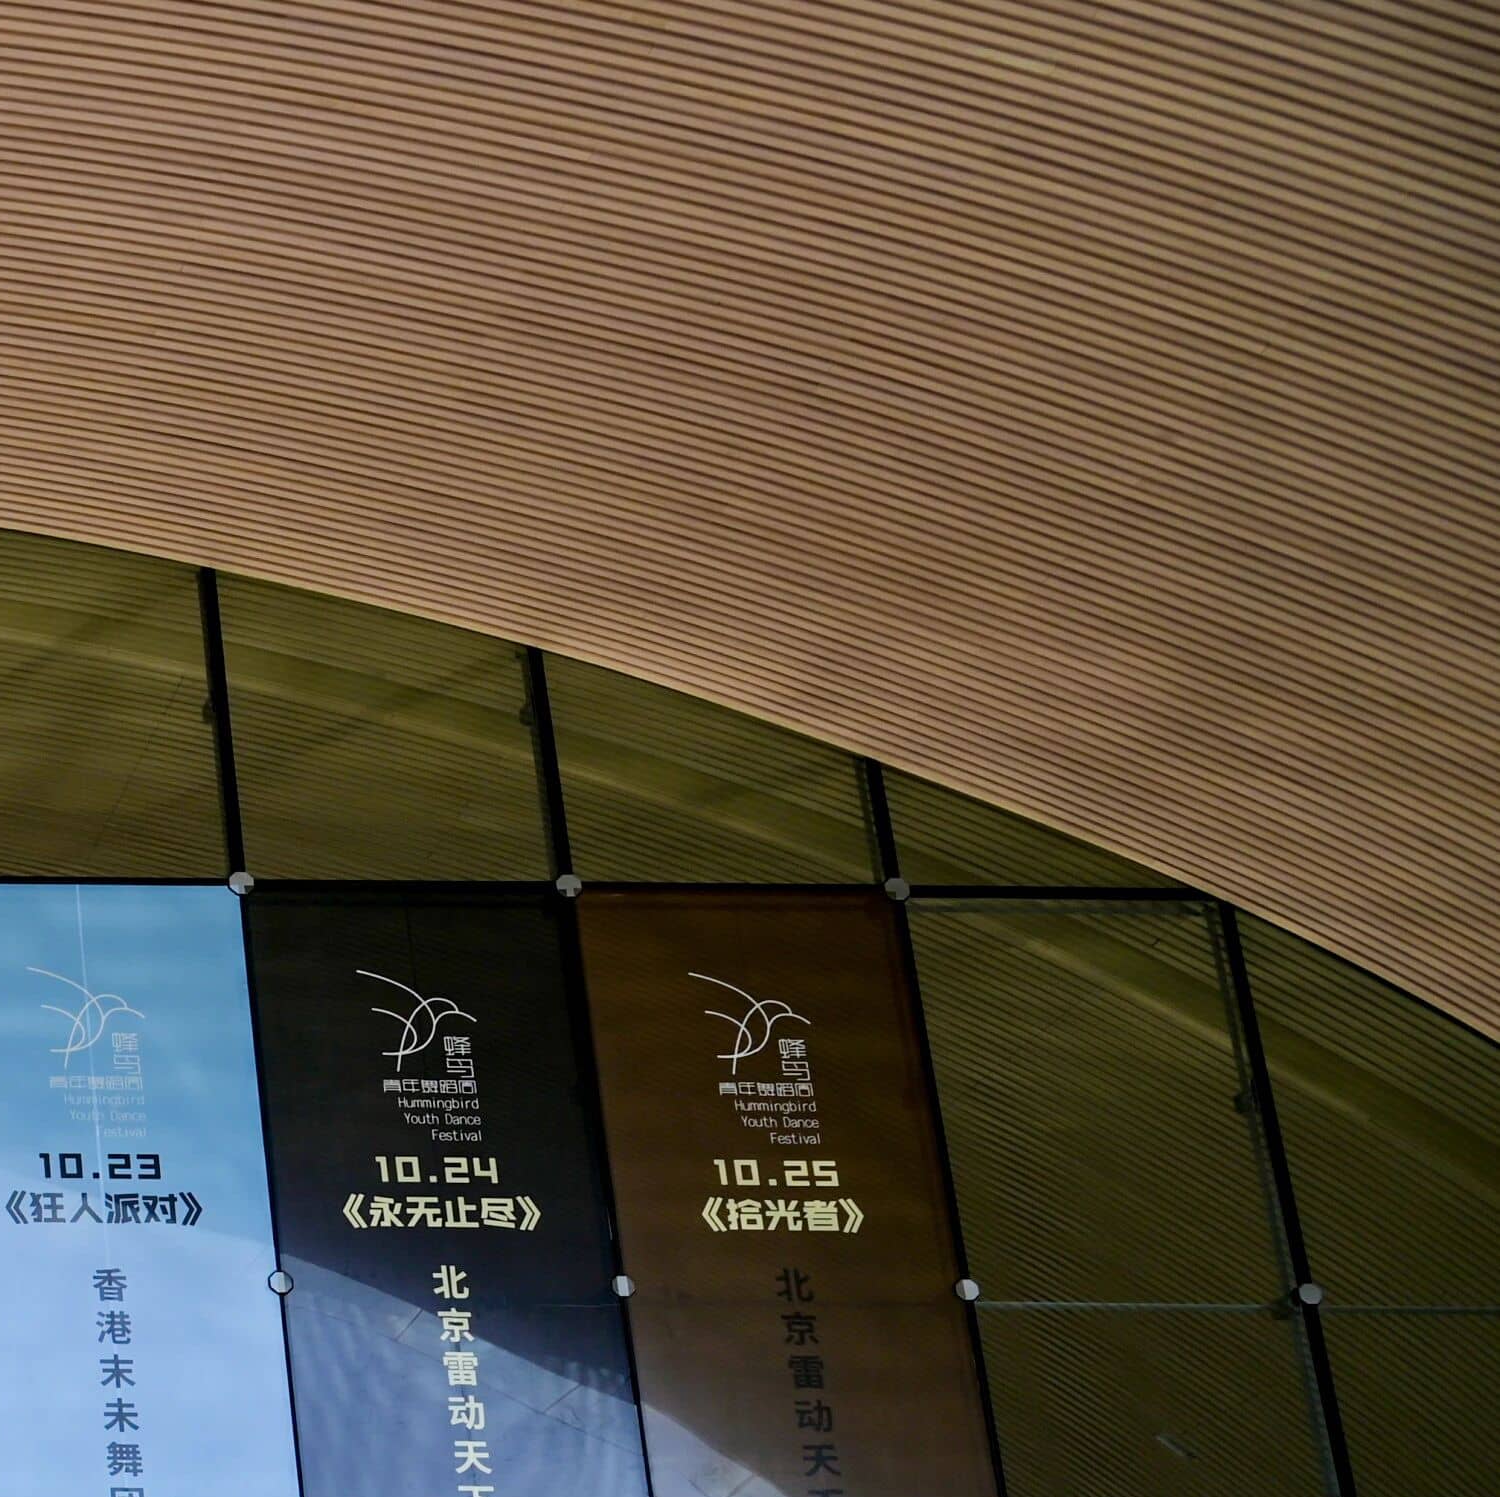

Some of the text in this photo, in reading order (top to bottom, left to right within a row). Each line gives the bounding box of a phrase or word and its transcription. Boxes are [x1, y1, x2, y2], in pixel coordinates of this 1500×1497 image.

[443, 1036, 474, 1078] 蜂鸟
[778, 1038, 811, 1080] 蜂鸟
[398, 1096, 480, 1111] Hummingbird
[734, 1100, 817, 1114] Hummingbird
[404, 1113, 482, 1126] Youth Dance
[741, 1116, 819, 1128] Youth Dance
[432, 1129, 482, 1142] Festival
[770, 1132, 821, 1145] Festival
[39, 1152, 161, 1181] 10.23
[375, 1155, 499, 1185] 10.24
[713, 1159, 840, 1188] 10.25
[5, 1191, 203, 1228] 《狂人派对》
[340, 1193, 541, 1231] 《永无止尽》
[701, 1197, 864, 1235] 《拾光者》
